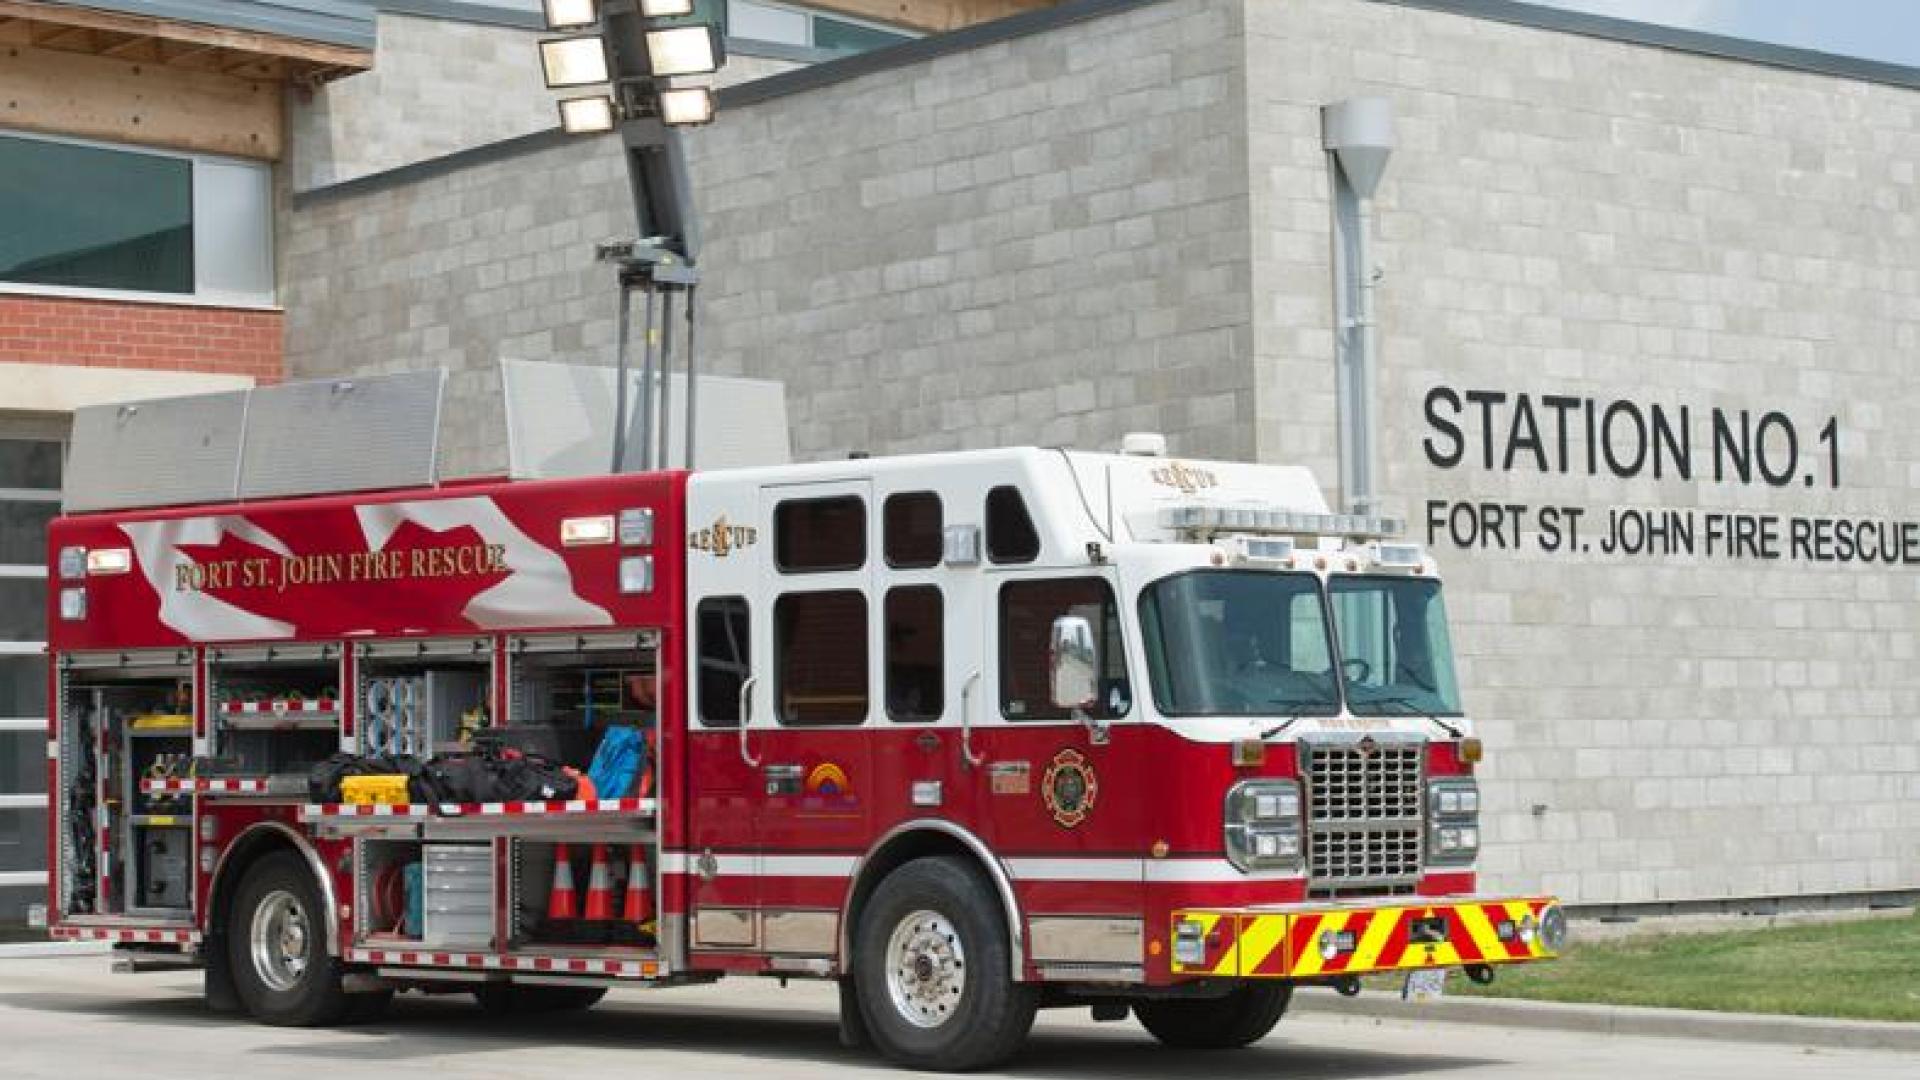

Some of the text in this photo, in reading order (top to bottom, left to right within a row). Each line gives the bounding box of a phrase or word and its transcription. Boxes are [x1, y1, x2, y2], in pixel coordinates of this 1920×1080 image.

[1424, 386, 1840, 488] STATION NO.1
[1426, 500, 1920, 565] FORT ST. JOHN FIRE RESCUE
[174, 543, 508, 593] FORT ST. JOHN FIRE RESCUE
